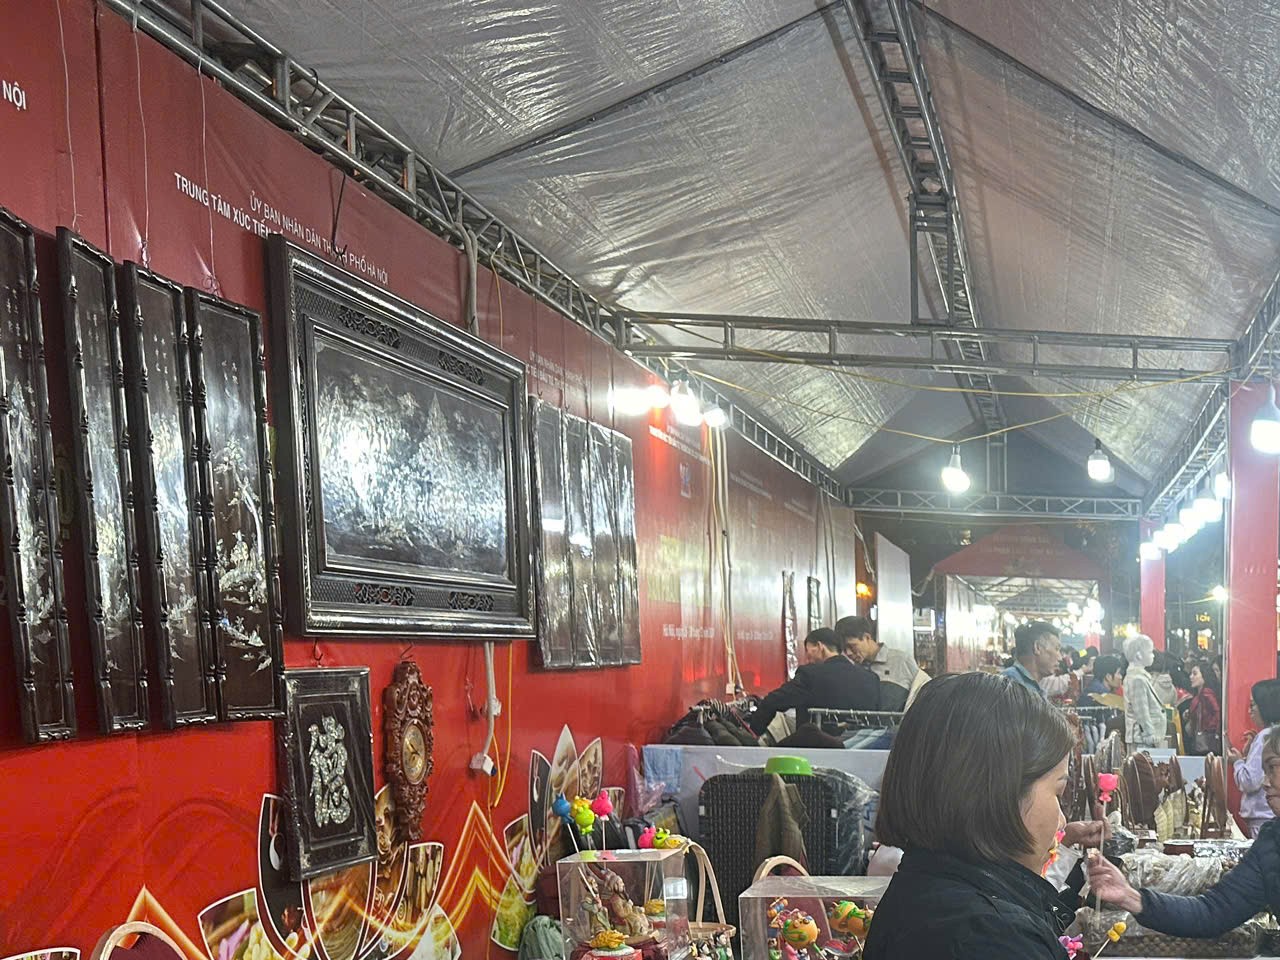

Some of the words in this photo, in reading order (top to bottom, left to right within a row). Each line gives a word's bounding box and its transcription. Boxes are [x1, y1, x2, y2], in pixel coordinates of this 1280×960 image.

[2, 79, 27, 111] NỘI
[174, 172, 209, 206] TRUNG
[210, 193, 231, 219] TÂM
[232, 206, 251, 231] XÚC
[250, 190, 263, 212] ỦY
[264, 203, 281, 226] BAN
[282, 213, 305, 239] NHÂN
[306, 228, 322, 249] DÂN
[349, 252, 367, 273] PHỐ
[377, 267, 389, 286] NỘI
